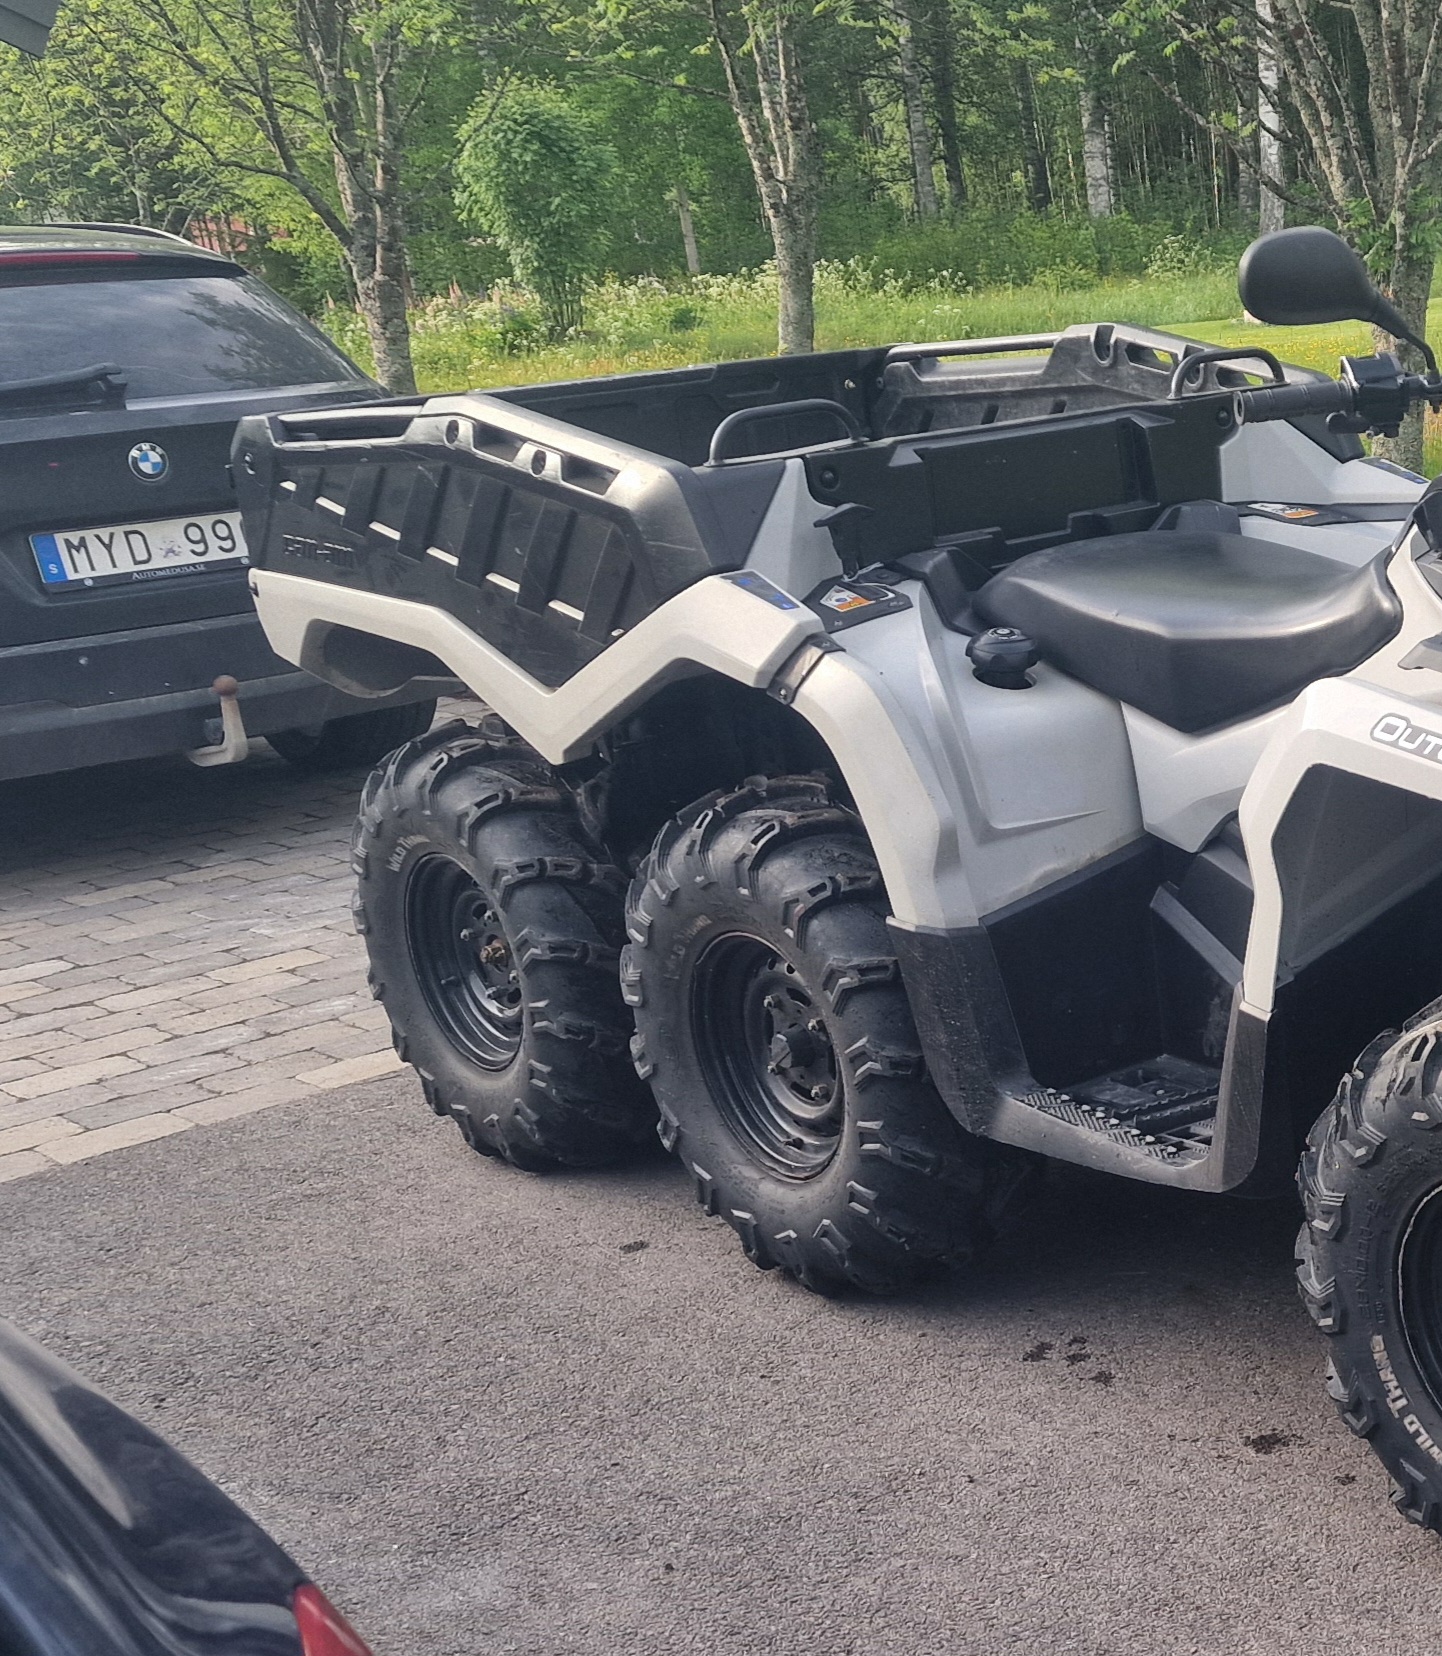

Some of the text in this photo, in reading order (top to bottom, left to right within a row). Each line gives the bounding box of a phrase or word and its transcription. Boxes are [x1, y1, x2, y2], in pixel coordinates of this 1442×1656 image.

[63, 518, 249, 574] MYD 99
[48, 563, 59, 574] S
